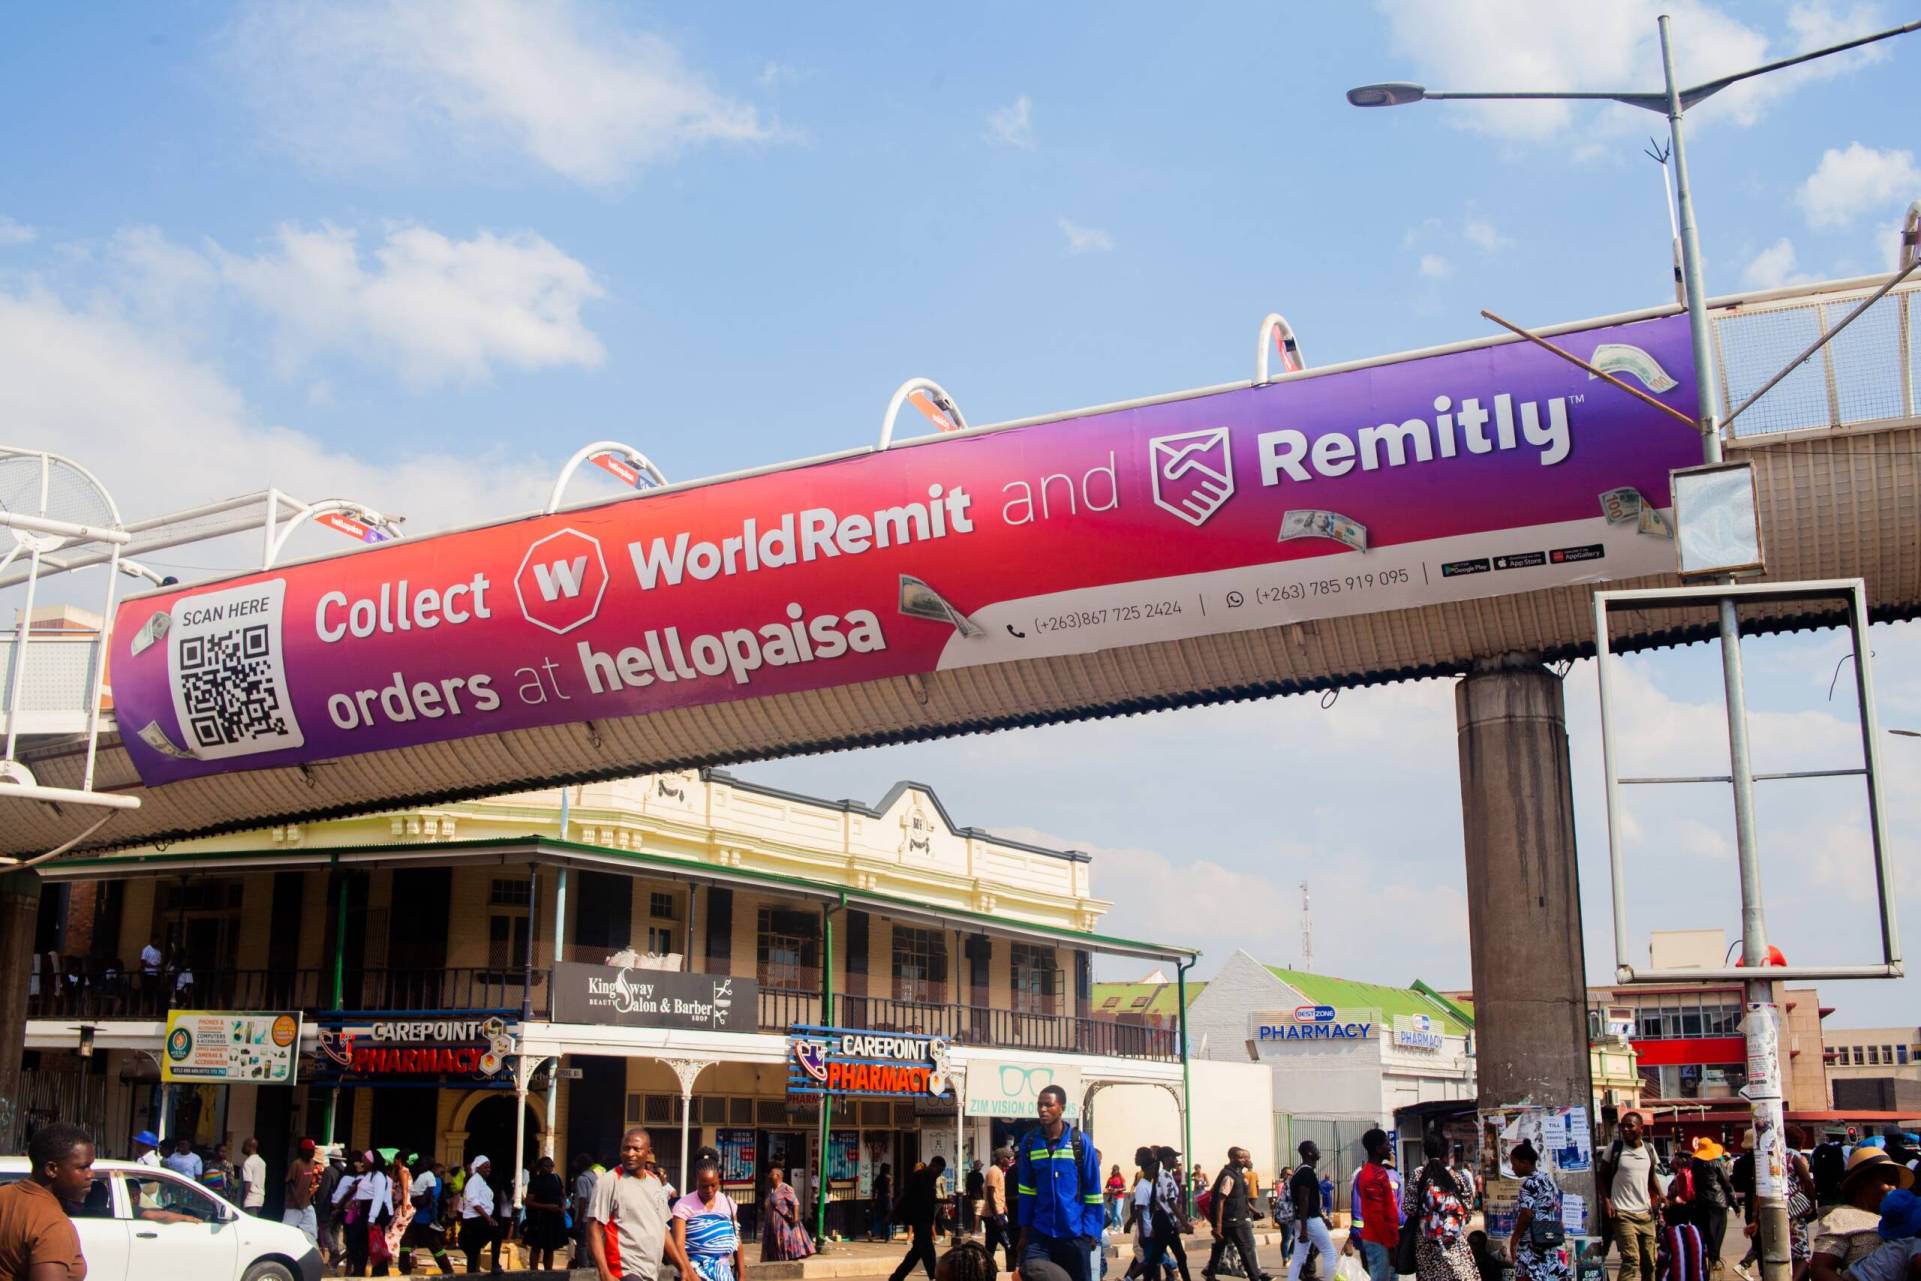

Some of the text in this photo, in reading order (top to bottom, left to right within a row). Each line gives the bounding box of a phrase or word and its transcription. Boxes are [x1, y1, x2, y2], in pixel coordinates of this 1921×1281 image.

[1257, 394, 1572, 487] Remitly
[1002, 451, 1119, 526] and
[628, 483, 974, 591] WorldRemit
[1509, 558, 1542, 568] App Store
[1565, 551, 1600, 561] AppGallery
[1256, 568, 1409, 605] (+263) 785 919 095
[183, 597, 270, 627] SCAN HERE
[315, 572, 491, 643] Collect
[1034, 600, 1182, 634] (+263)867 725 2424
[328, 603, 887, 730] orders at hellopaisa
[659, 999, 671, 1013] &
[674, 1000, 713, 1016] Barber
[371, 1022, 480, 1041] CAREPOINT
[1259, 1023, 1371, 1040] PHARMACY
[1400, 1030, 1443, 1049] PHARMACY
[354, 1048, 484, 1073] PHARMACY
[842, 1035, 929, 1060] CAREPOINT
[828, 1063, 932, 1092] PHARMACY
[970, 1099, 988, 1113] ZIM
[991, 1101, 1025, 1114] VISION
